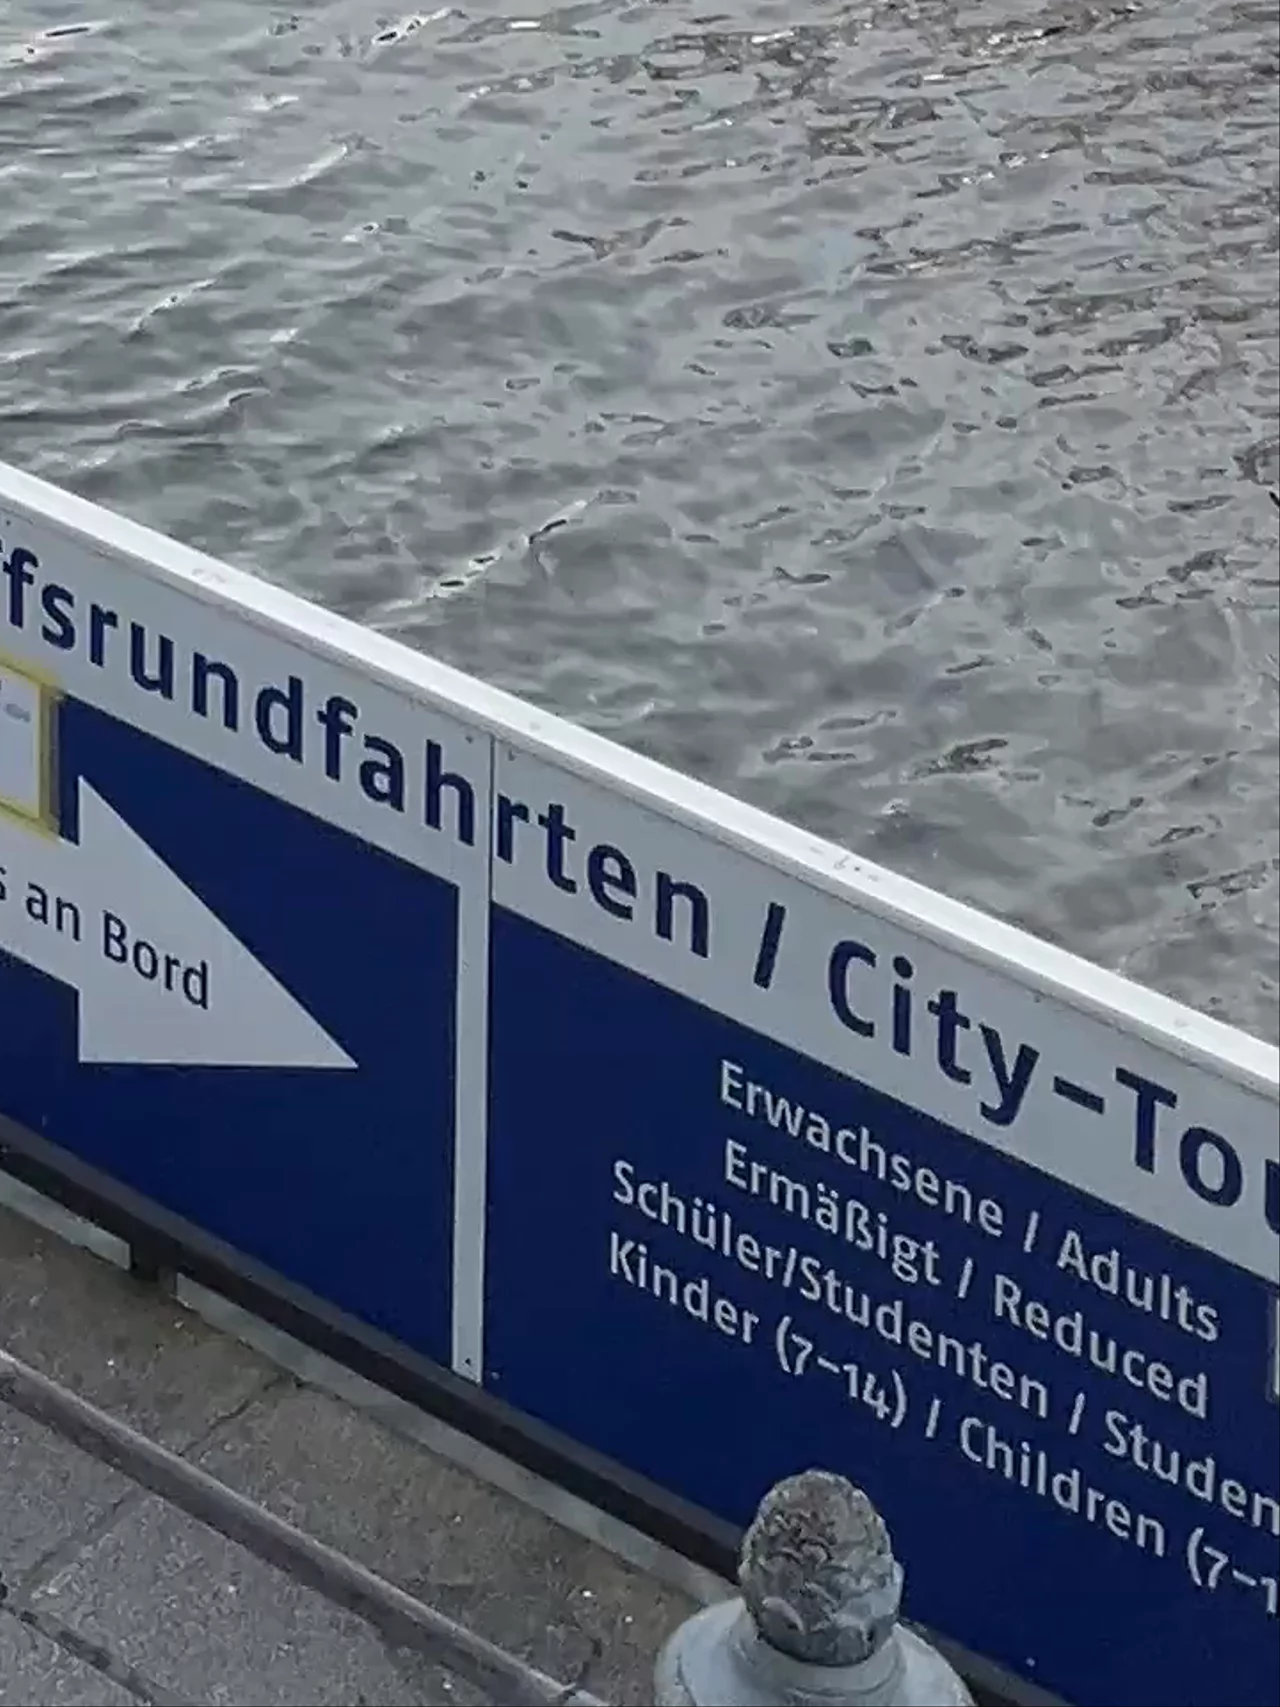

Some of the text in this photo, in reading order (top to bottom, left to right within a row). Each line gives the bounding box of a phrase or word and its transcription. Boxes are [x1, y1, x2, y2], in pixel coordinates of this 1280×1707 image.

[25, 882, 81, 942] an
[101, 910, 209, 1011] Bord
[828, 940, 1280, 1234] City-To
[613, 1160, 1047, 1418] Schüler/Studenten
[721, 1059, 1003, 1237] Erwachsene
[1057, 1230, 1218, 1341] Adults
[725, 1139, 941, 1285] Ermäßigt
[994, 1274, 1207, 1419] Reduced
[610, 1232, 760, 1344] Kinder
[960, 1417, 1164, 1557] Children
